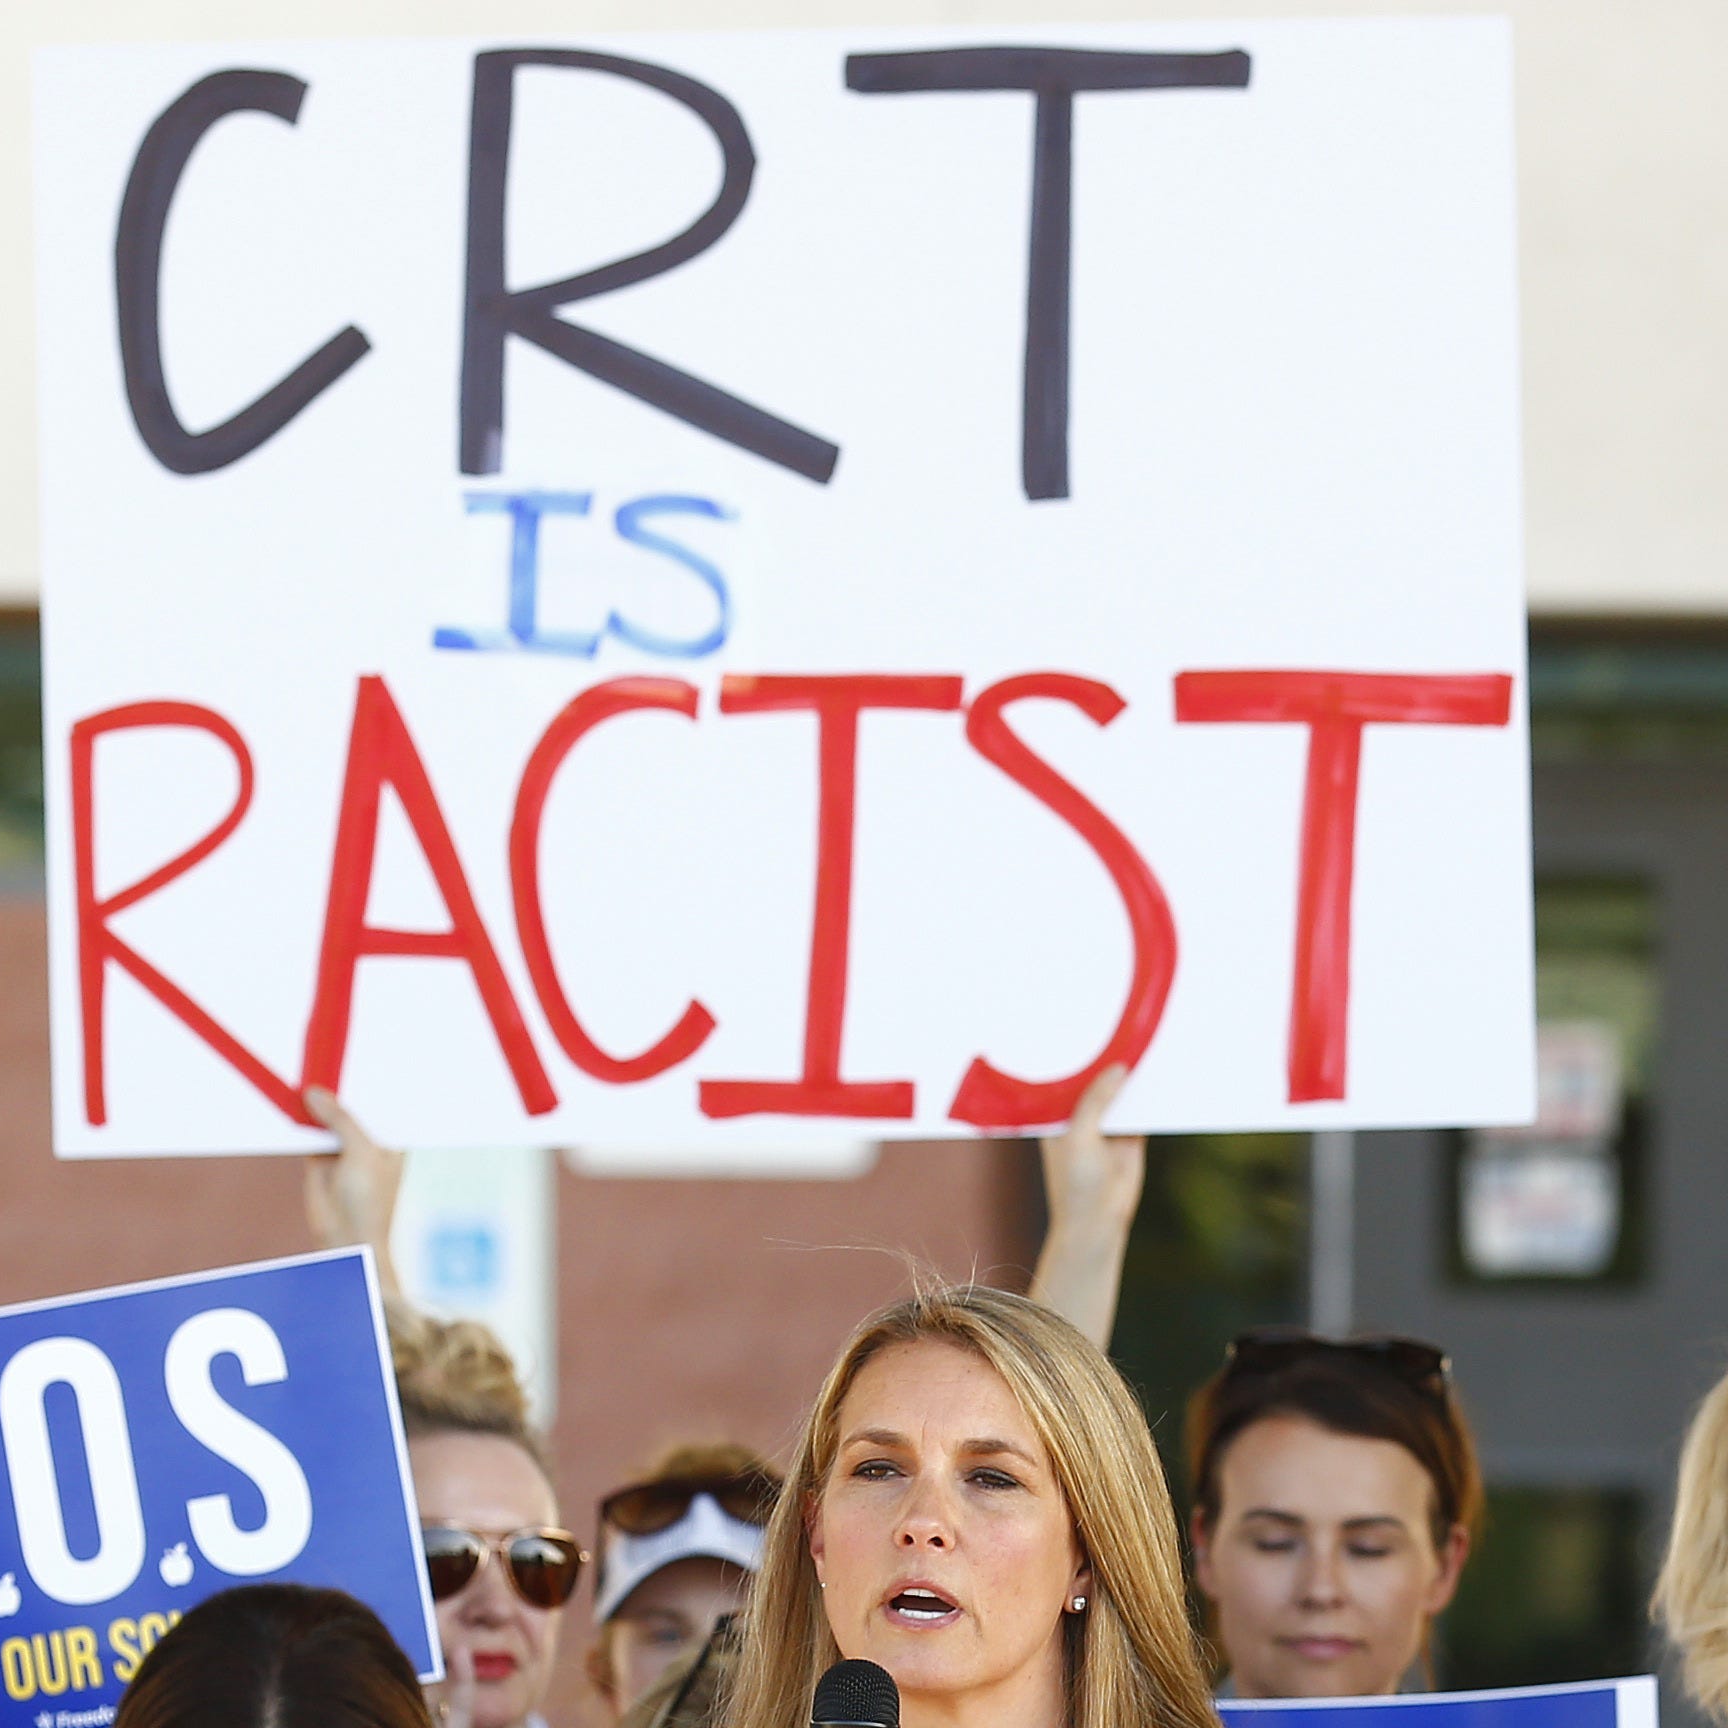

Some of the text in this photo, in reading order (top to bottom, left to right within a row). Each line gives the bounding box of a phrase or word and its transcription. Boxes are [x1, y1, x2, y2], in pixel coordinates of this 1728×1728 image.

[114, 45, 1252, 500] CRT
[431, 490, 739, 660] IS
[68, 670, 1513, 1132] RACIST
[0, 1626, 103, 1702] OUR
